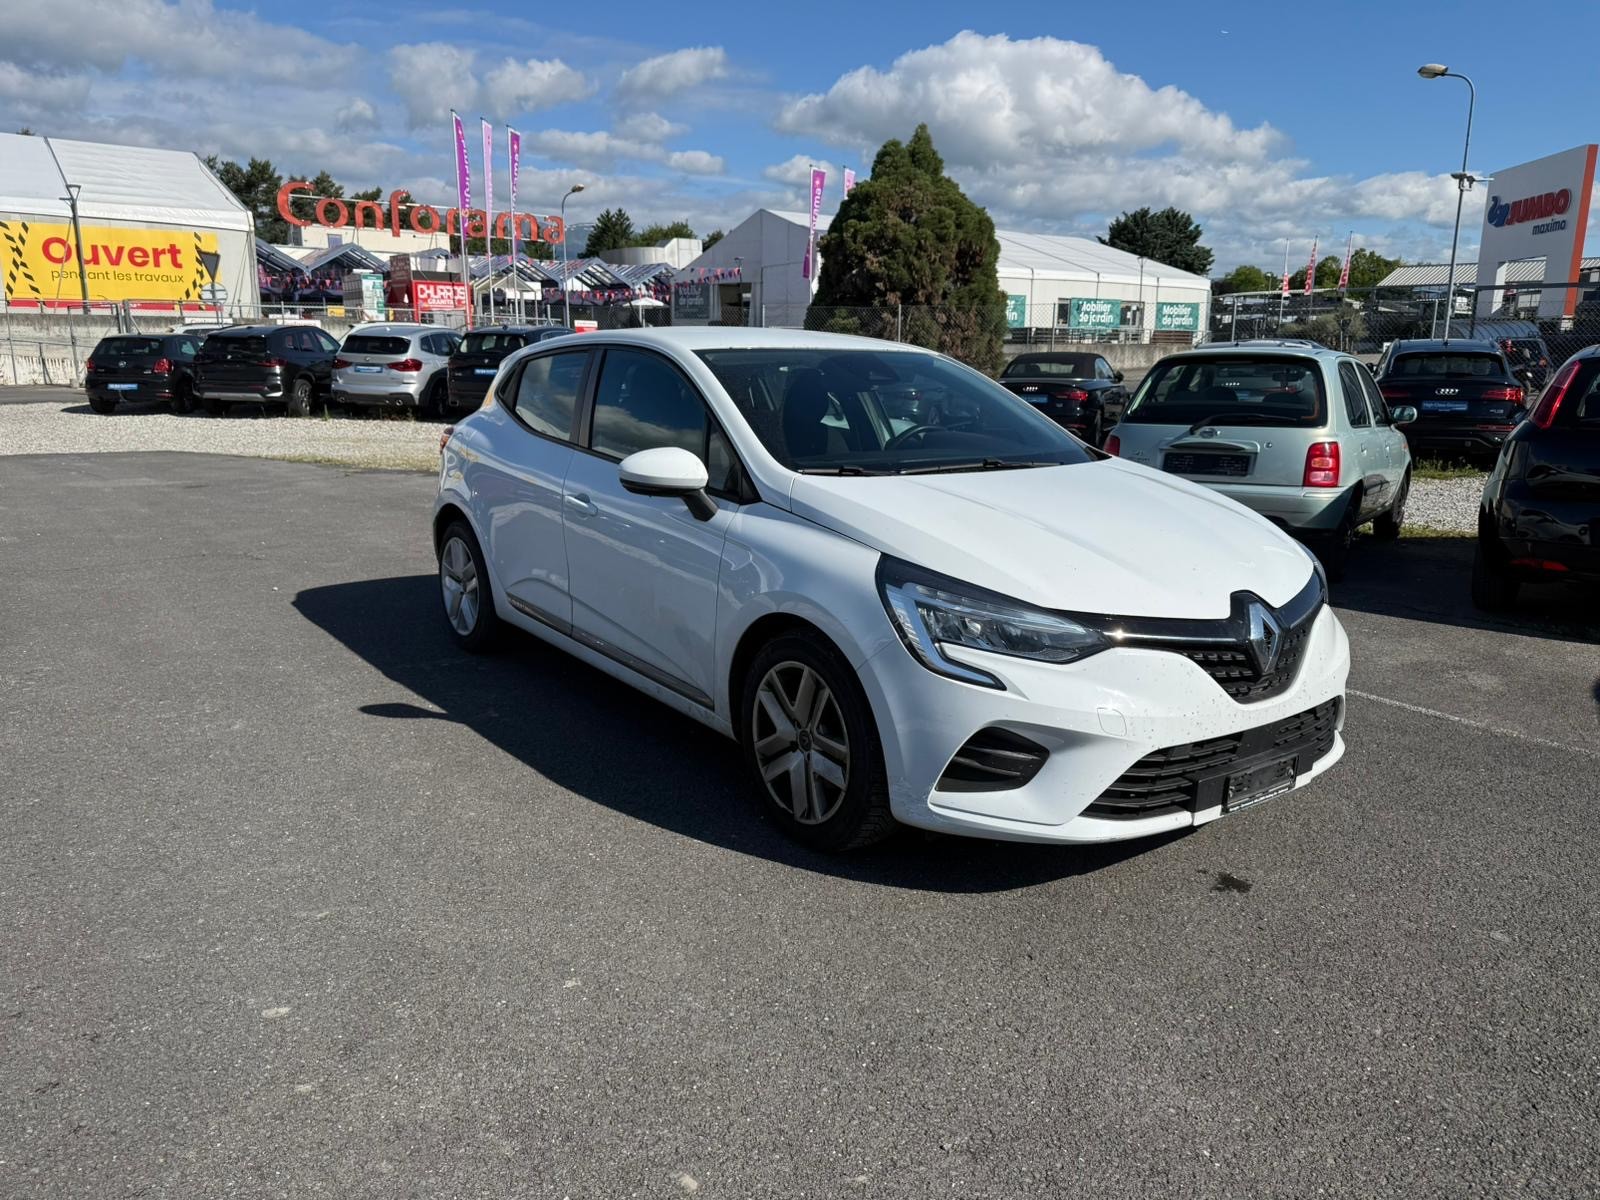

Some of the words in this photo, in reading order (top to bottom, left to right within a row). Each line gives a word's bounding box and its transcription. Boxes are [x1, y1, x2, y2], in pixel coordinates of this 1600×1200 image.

[276, 181, 566, 244] Conforama
[1505, 188, 1571, 226] JUMBO
[41, 236, 184, 269] Ouvert
[113, 270, 132, 281] les
[135, 272, 184, 283] travaux
[417, 284, 466, 299] CHURROS
[1162, 304, 1192, 315] Mobilier
[1162, 315, 1172, 325] de
[1171, 314, 1193, 328] jardin
